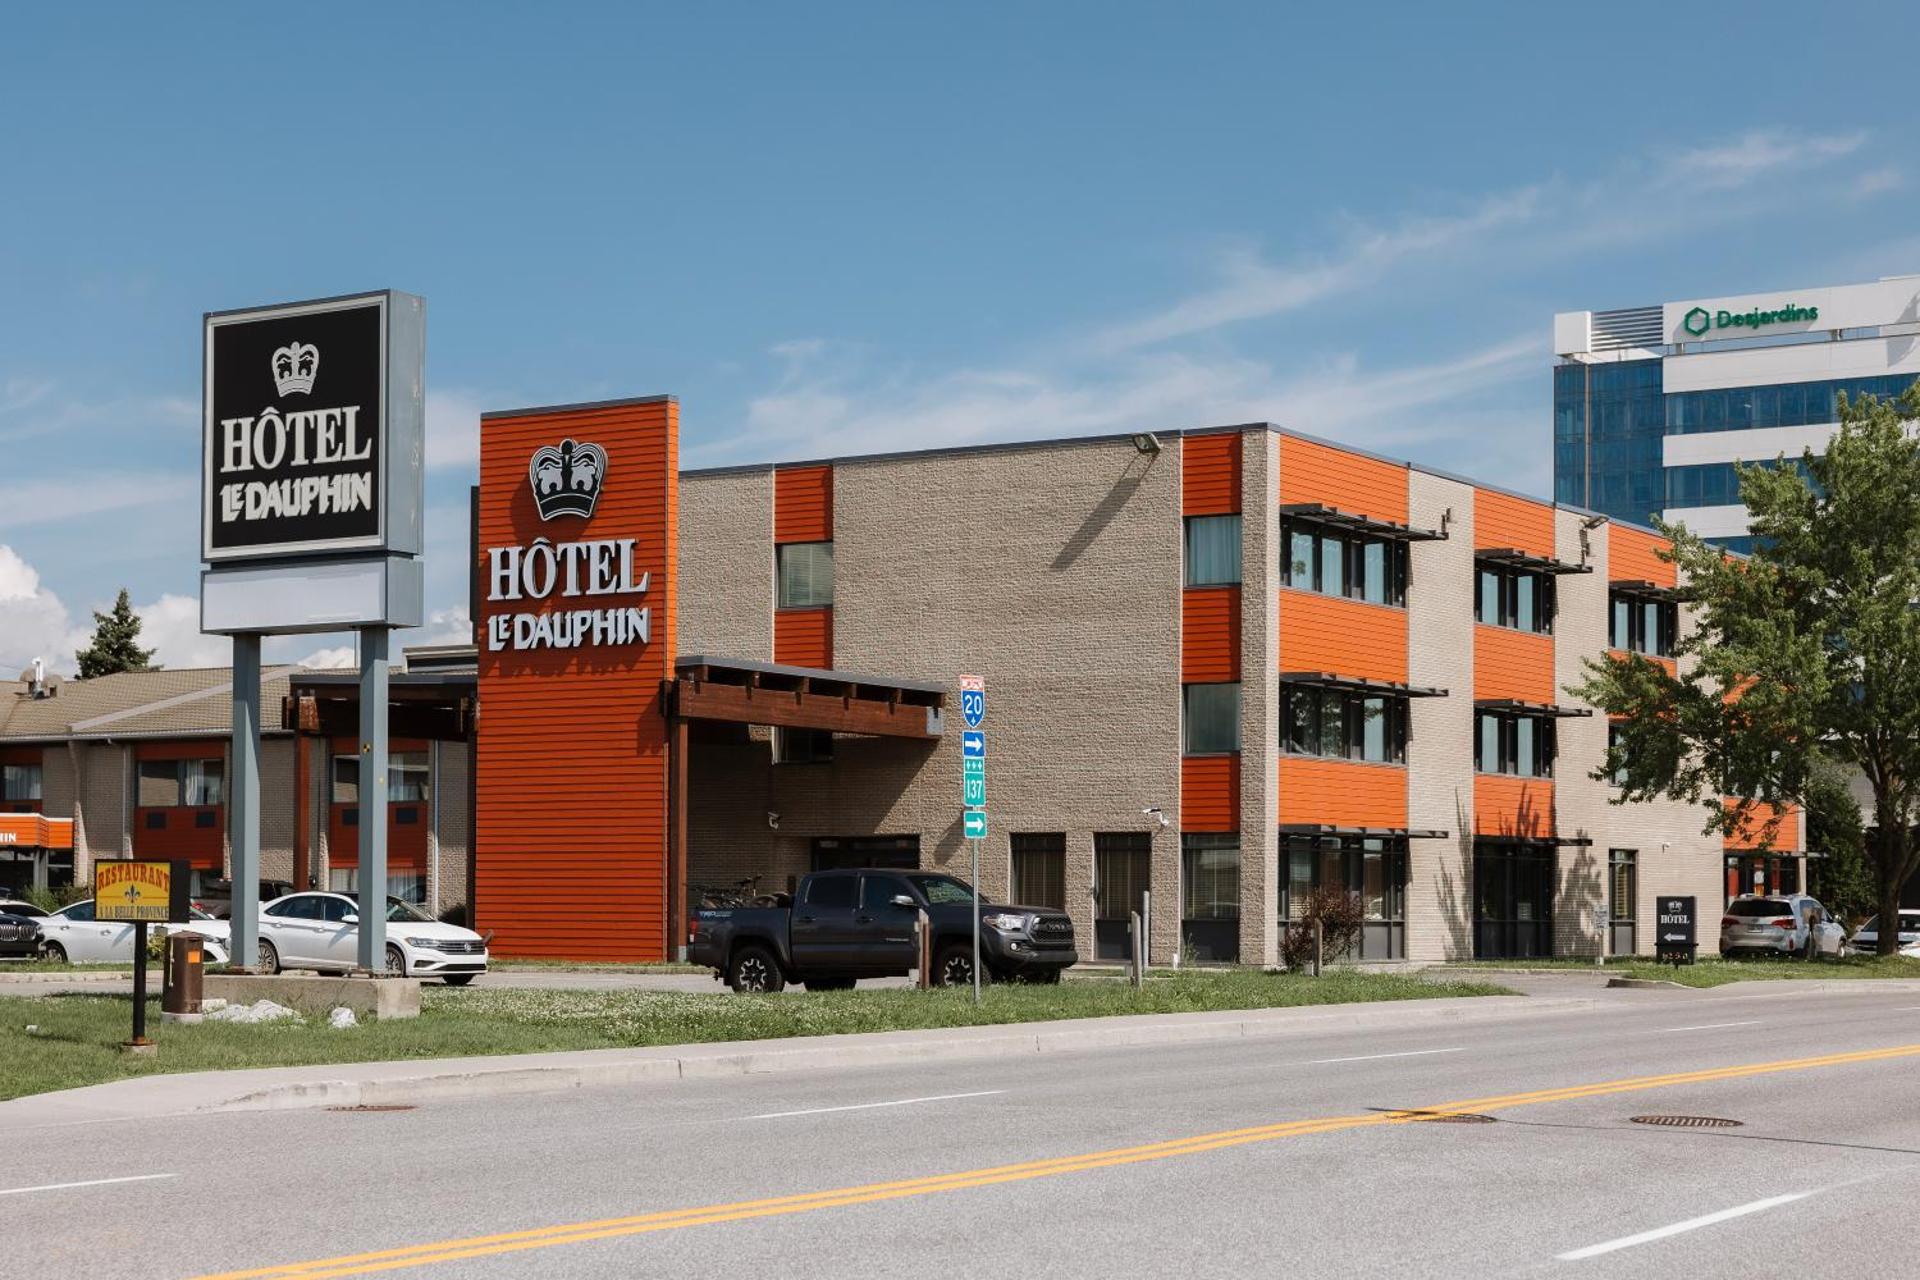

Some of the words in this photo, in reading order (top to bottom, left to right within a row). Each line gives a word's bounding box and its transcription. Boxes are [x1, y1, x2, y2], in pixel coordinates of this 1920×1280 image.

[1717, 303, 1819, 330] Desjardins
[220, 405, 372, 473] HÔTEL
[244, 471, 372, 520] DAUPHIN
[487, 537, 649, 601] HÔTEL
[513, 607, 649, 650] DAUPHIN
[964, 694, 983, 715] 20
[966, 779, 983, 800] 137
[98, 863, 170, 893] RESTAURANT
[1660, 913, 1690, 924] HÔTEL
